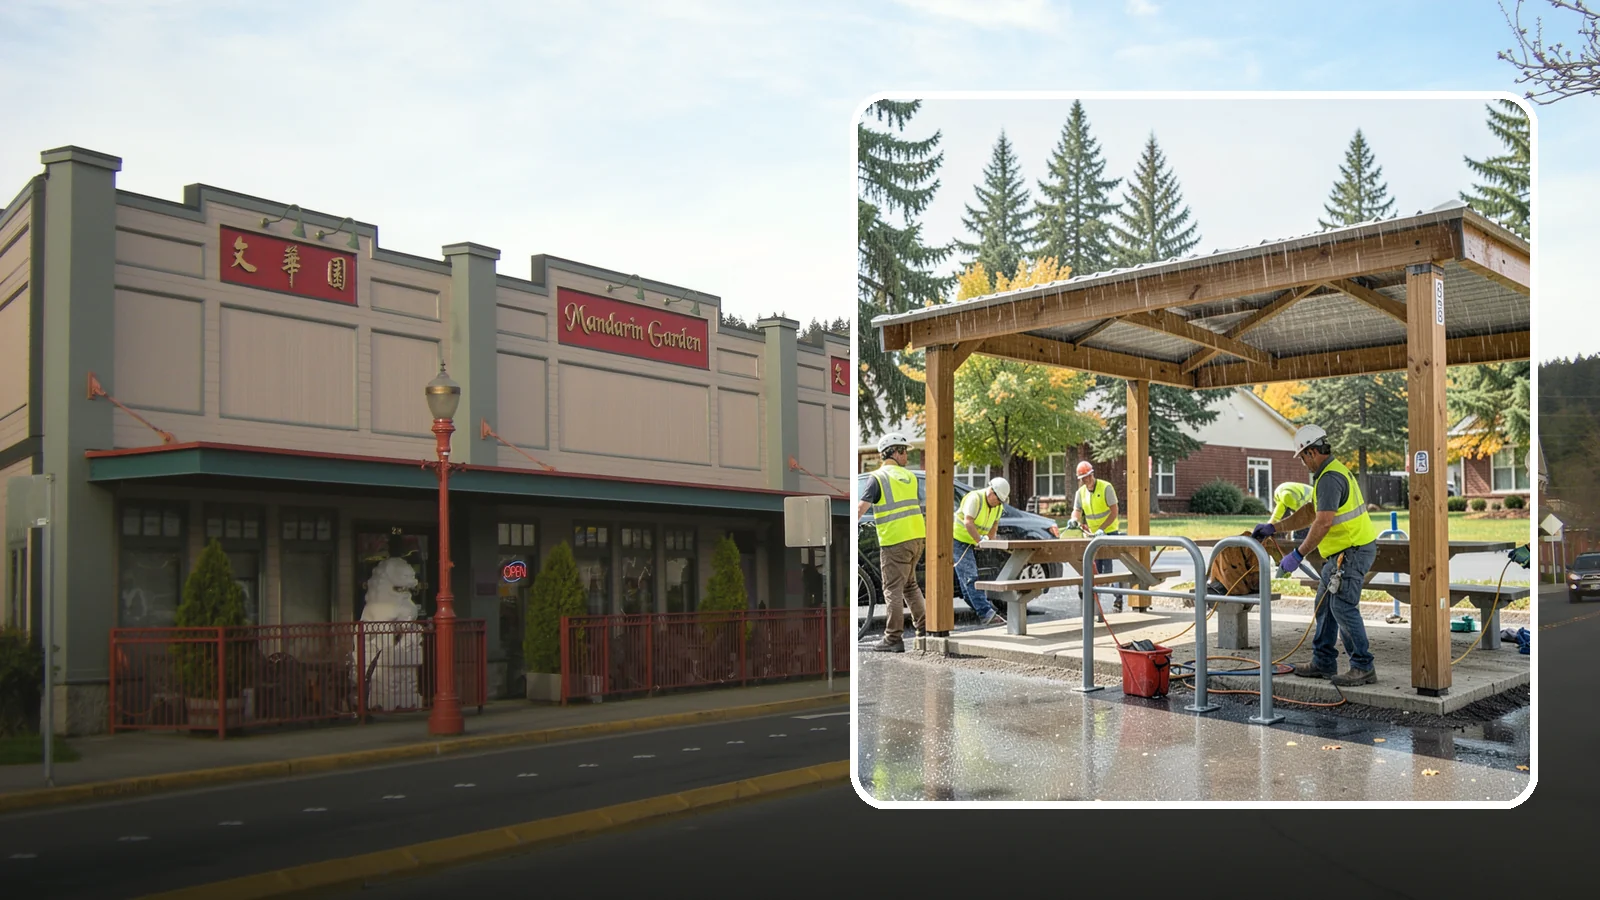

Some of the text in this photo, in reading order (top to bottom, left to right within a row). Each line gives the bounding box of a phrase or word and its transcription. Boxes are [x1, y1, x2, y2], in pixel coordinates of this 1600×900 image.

[230, 235, 347, 291] 文華園
[564, 302, 702, 352] Mandarin Garden
[503, 565, 527, 578] OPEN
